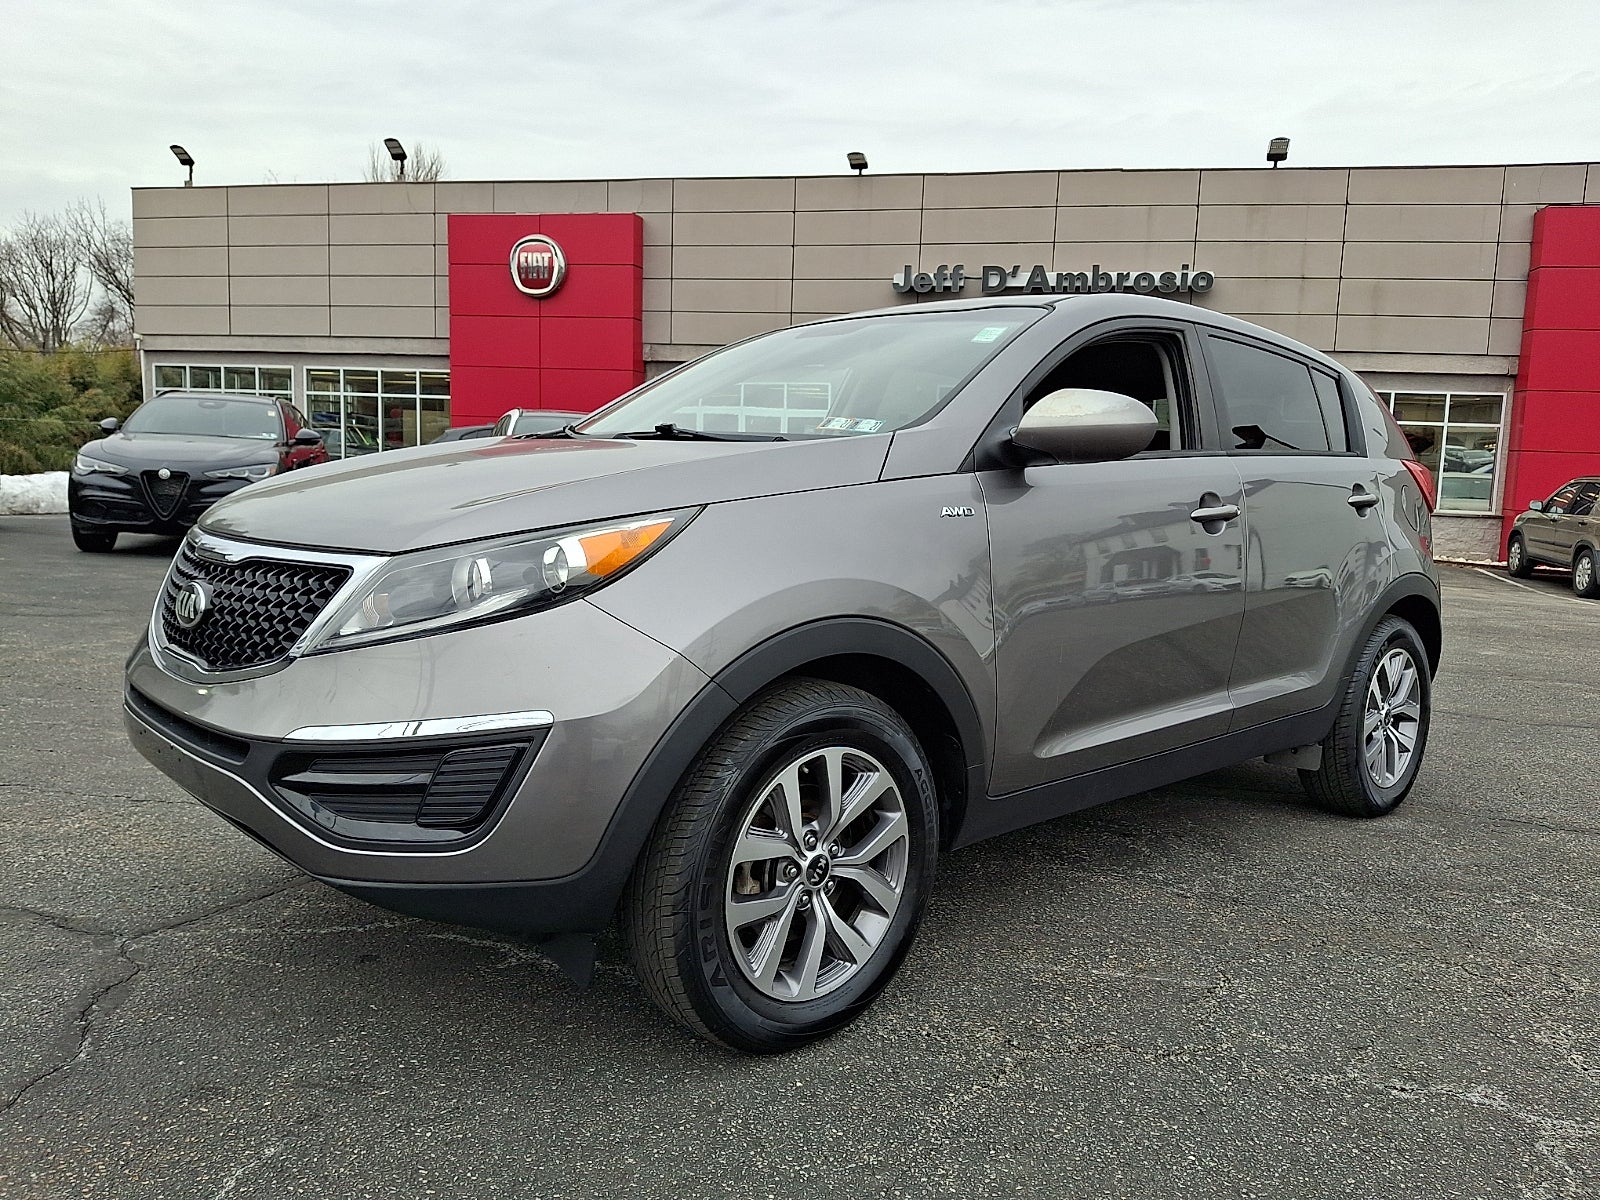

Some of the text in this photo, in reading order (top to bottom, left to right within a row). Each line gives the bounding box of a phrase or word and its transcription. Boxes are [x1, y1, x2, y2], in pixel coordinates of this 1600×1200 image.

[520, 251, 552, 279] FIAT
[892, 263, 1215, 294] Jeff D'Ambrosio
[940, 505, 976, 518] AWD
[177, 590, 197, 619] KIA
[810, 857, 827, 882] KIA
